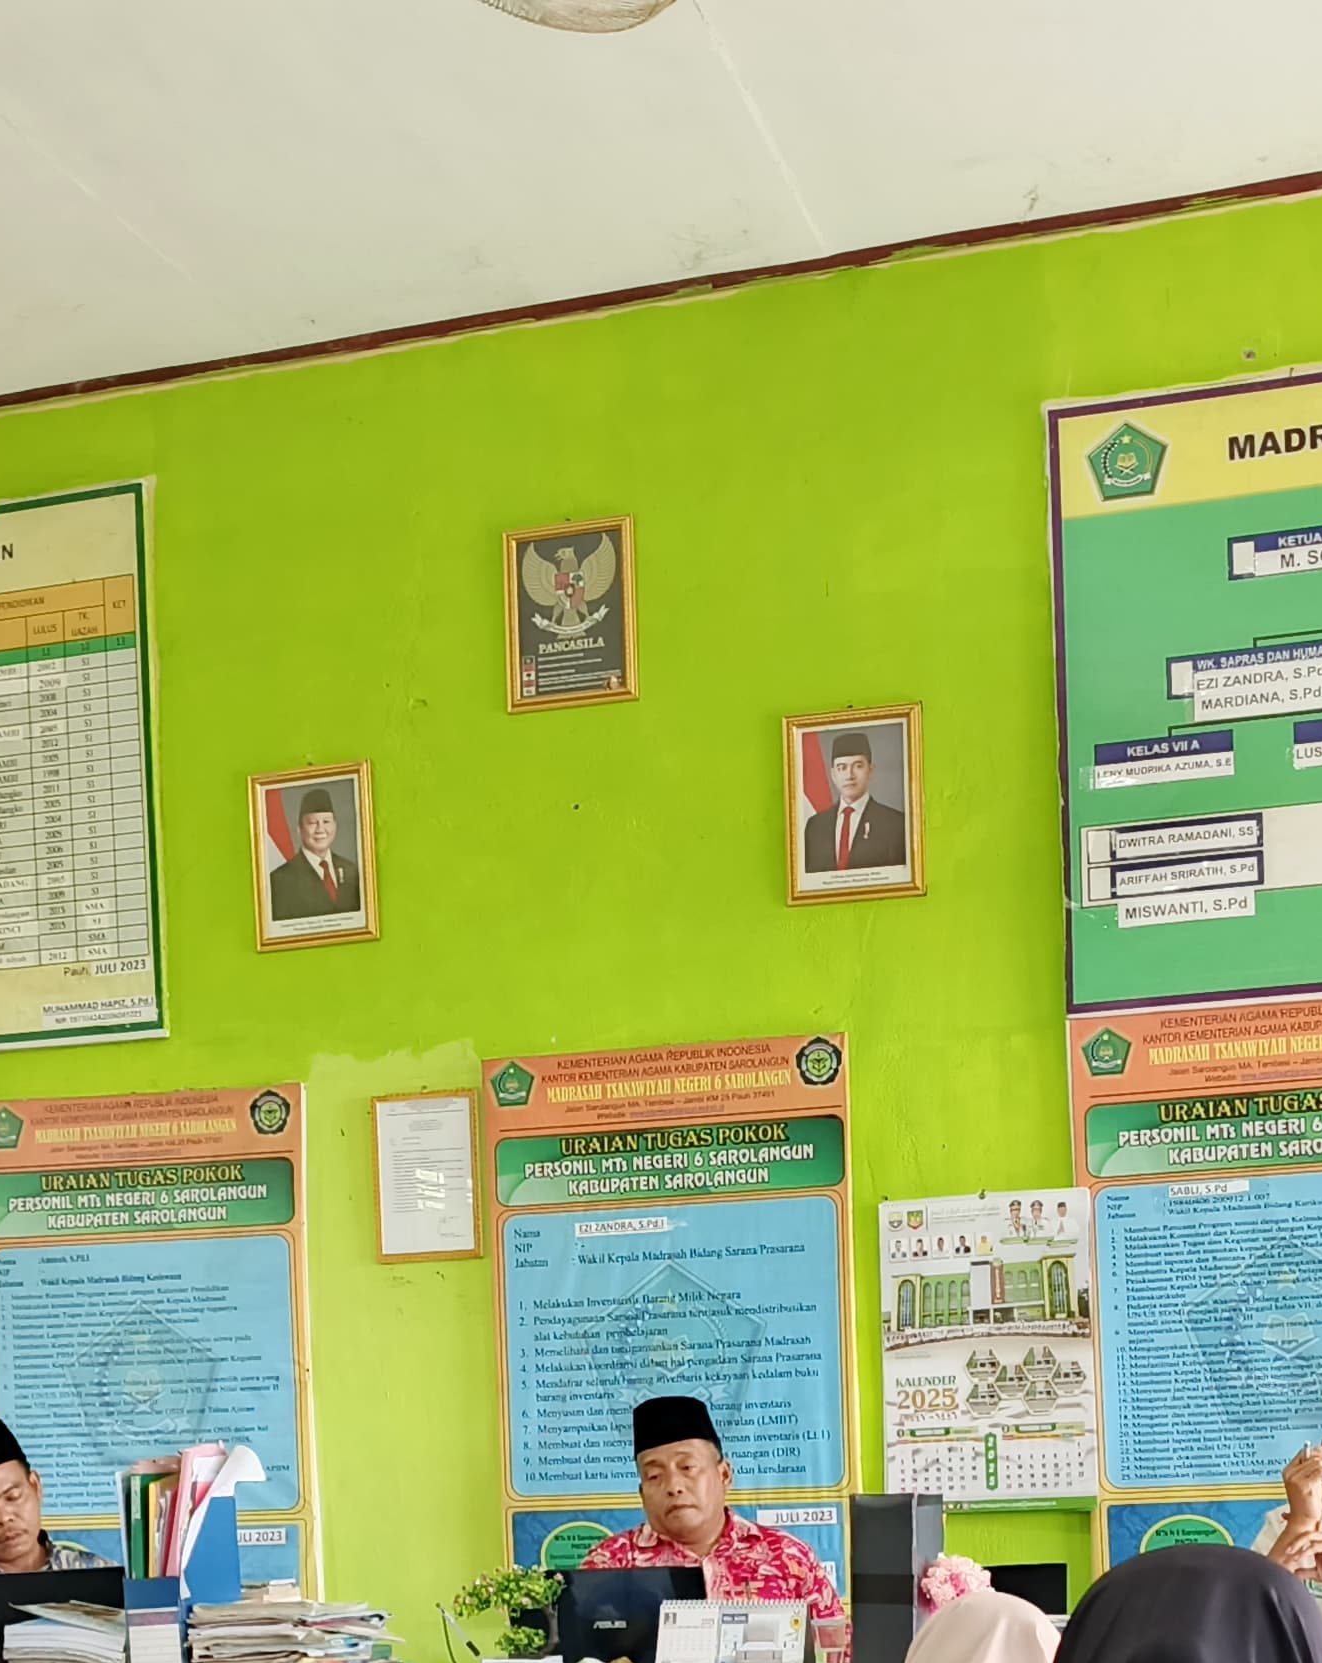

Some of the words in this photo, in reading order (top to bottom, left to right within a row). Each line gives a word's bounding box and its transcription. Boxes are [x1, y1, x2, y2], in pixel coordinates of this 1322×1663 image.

[1278, 532, 1322, 546] KETUA
[1280, 552, 1300, 568] M.
[539, 637, 605, 654] PANCASILA
[1159, 1098, 1249, 1121] URAIAN
[561, 1136, 640, 1155] URAIAN
[643, 1127, 712, 1148] TUGAS
[718, 1124, 785, 1144] POKOK
[1119, 1126, 1200, 1149] PERSONIL
[1202, 1123, 1235, 1140] MTs
[1242, 1118, 1305, 1136] NEGERI
[1312, 1116, 1322, 1131] 6
[525, 1159, 596, 1180] PERSONIL
[598, 1157, 627, 1172] MTs
[632, 1152, 689, 1170] NEGERI
[693, 1152, 704, 1167] 6
[708, 1144, 813, 1165] SAROLANGUN
[1168, 1142, 1273, 1165] KABUPATEN
[41, 1173, 112, 1189] URAIAN
[115, 1168, 178, 1187] TUGAS
[183, 1165, 241, 1182] POKOK
[569, 1175, 659, 1194] KABUPATEN
[664, 1168, 768, 1188] SAROLANGUN
[9, 1195, 73, 1210] PERSONIL
[77, 1194, 101, 1207] MTs
[105, 1191, 159, 1206] NEGERI
[160, 1190, 170, 1203] 6
[169, 1185, 266, 1202] SAROLANGUN
[48, 1211, 129, 1227] KABUPATEN
[133, 1206, 226, 1223] SAROLANGUN
[895, 1375, 957, 1388] KALENDER
[896, 1388, 957, 1410] 2025
[775, 1511, 799, 1523] JULI
[803, 1510, 833, 1522] 2023
[593, 1620, 627, 1630] ASUS
